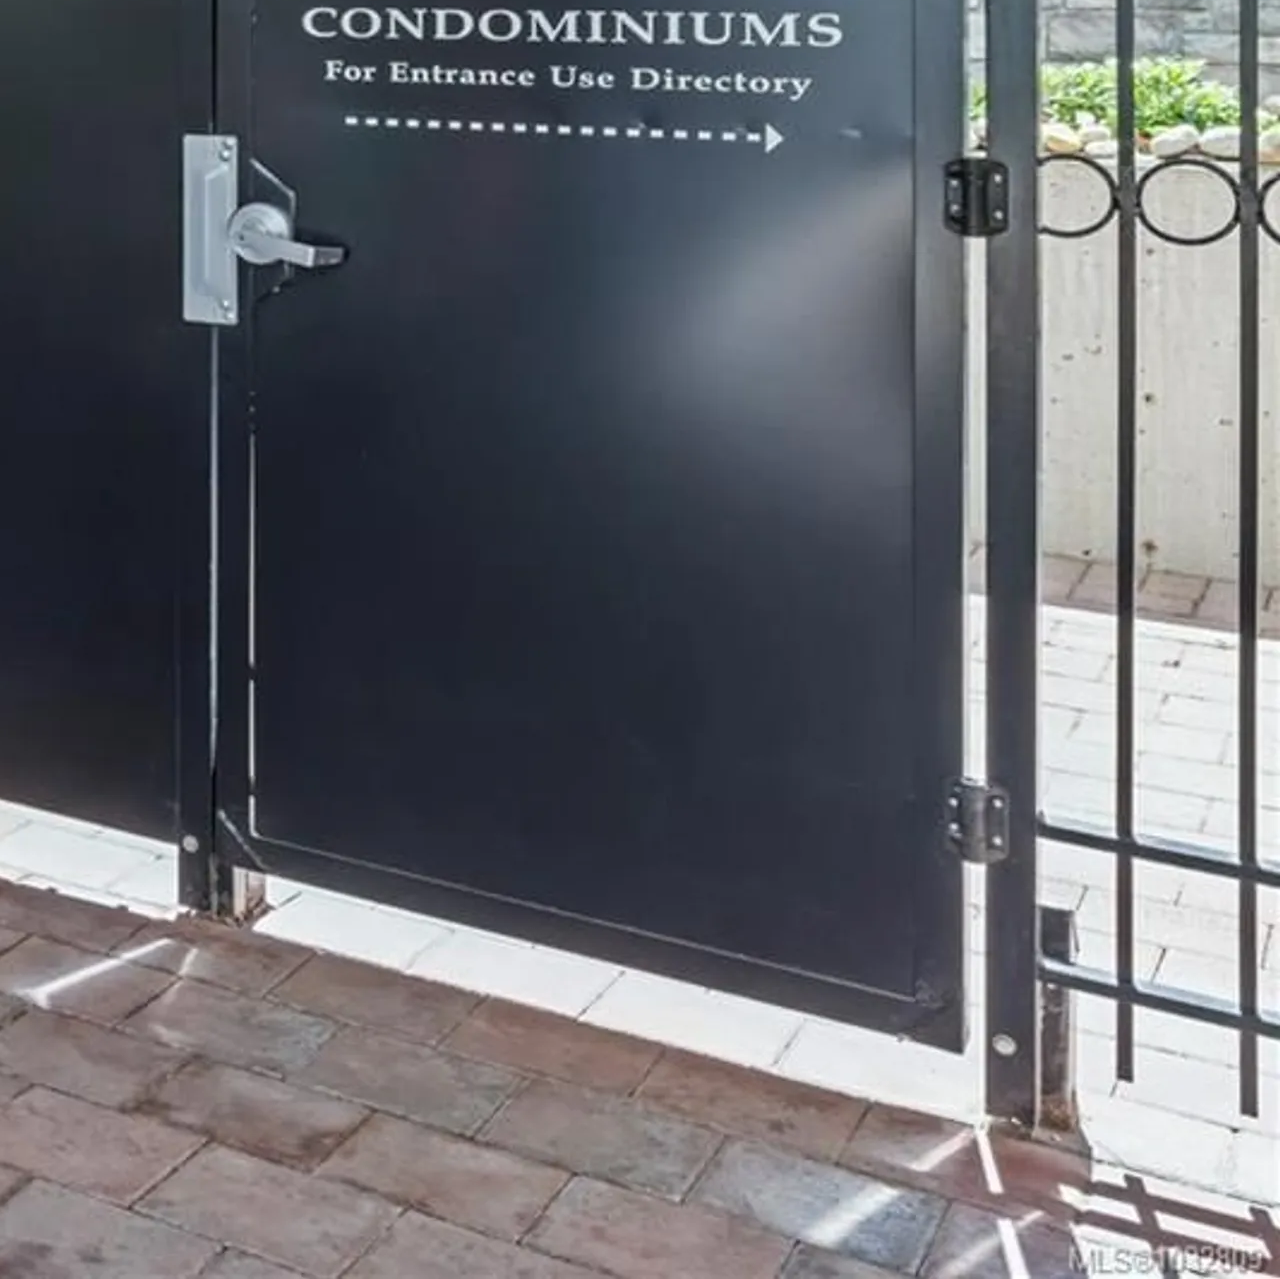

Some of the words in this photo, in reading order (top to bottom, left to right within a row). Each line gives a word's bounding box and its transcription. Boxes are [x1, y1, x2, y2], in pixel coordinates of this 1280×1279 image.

[301, 6, 843, 48] CONDOMINIUMS
[324, 59, 377, 82] For
[388, 61, 536, 86] Entrance
[549, 65, 615, 88] Use
[629, 67, 813, 101] Directory
